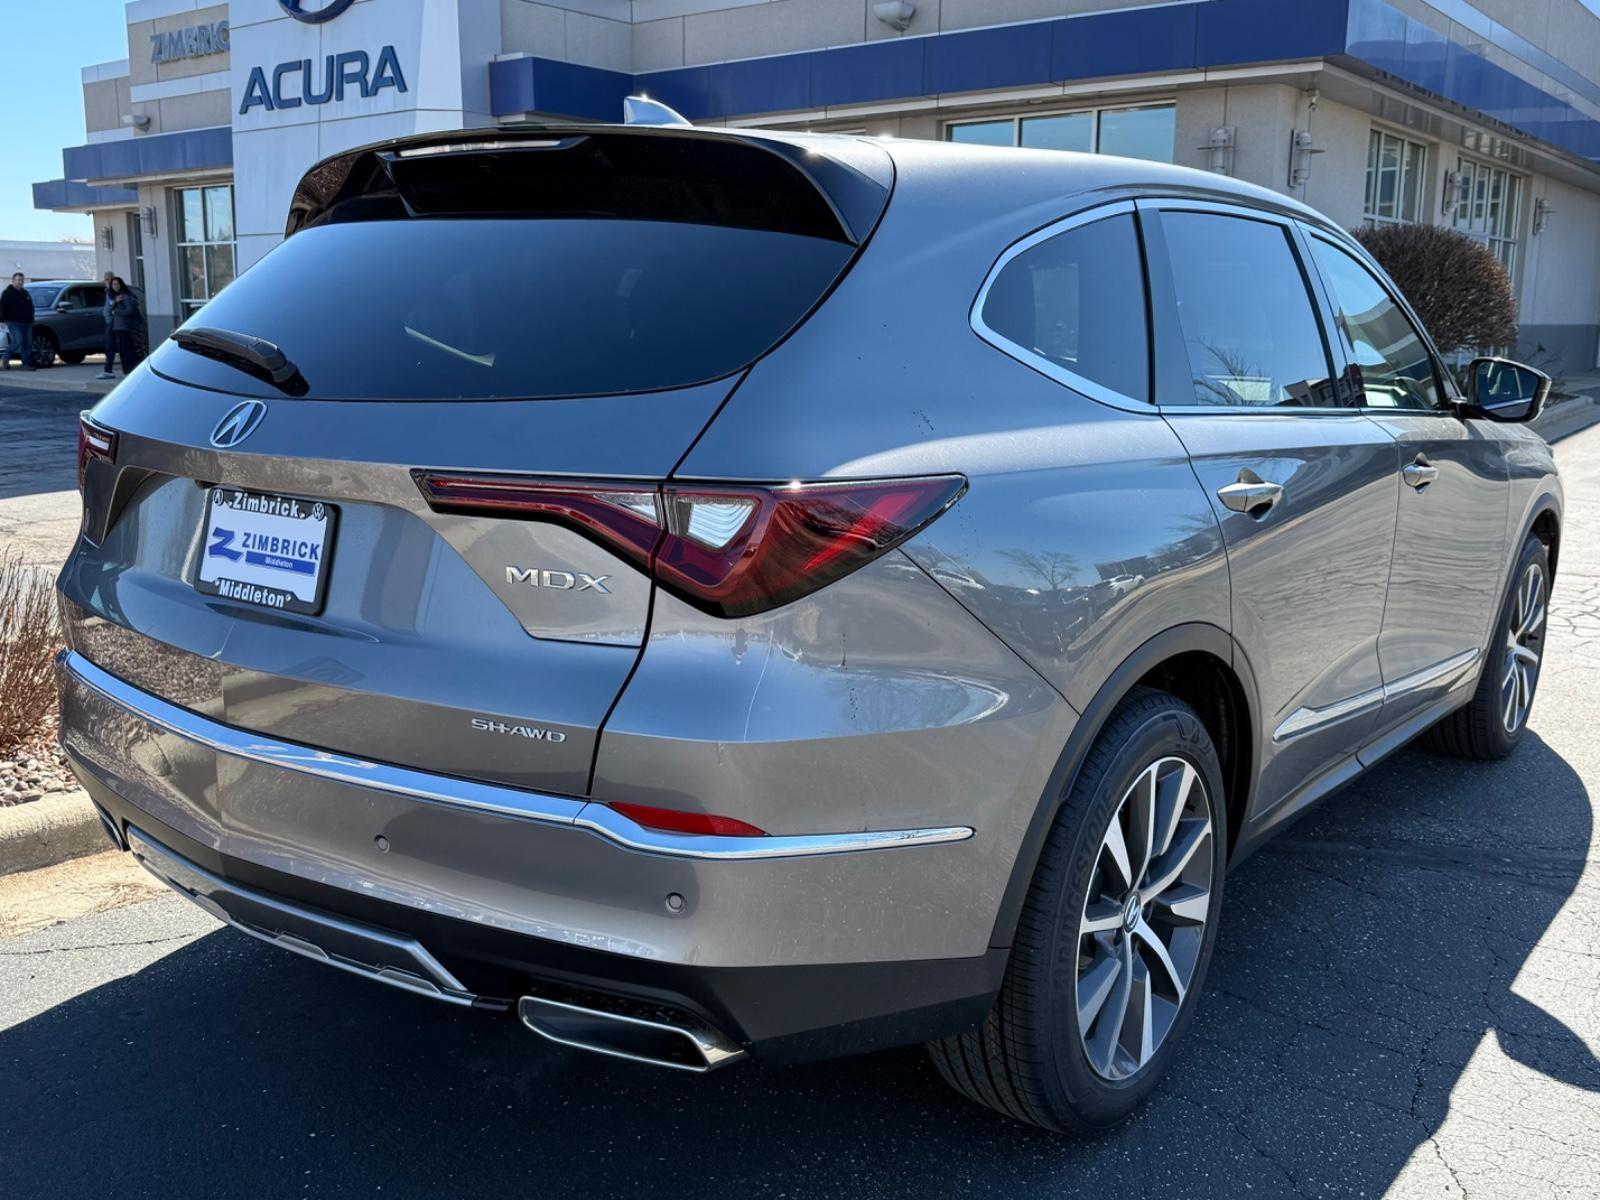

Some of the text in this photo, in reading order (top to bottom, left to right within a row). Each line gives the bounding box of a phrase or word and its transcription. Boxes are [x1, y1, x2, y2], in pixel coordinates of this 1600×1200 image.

[239, 45, 408, 115] ACURA
[233, 492, 300, 518] Zimbrick
[242, 532, 321, 561] ZIMBRICK
[219, 579, 285, 608] Middleton
[505, 566, 612, 594] MDX
[471, 718, 566, 743] SH-AWD
